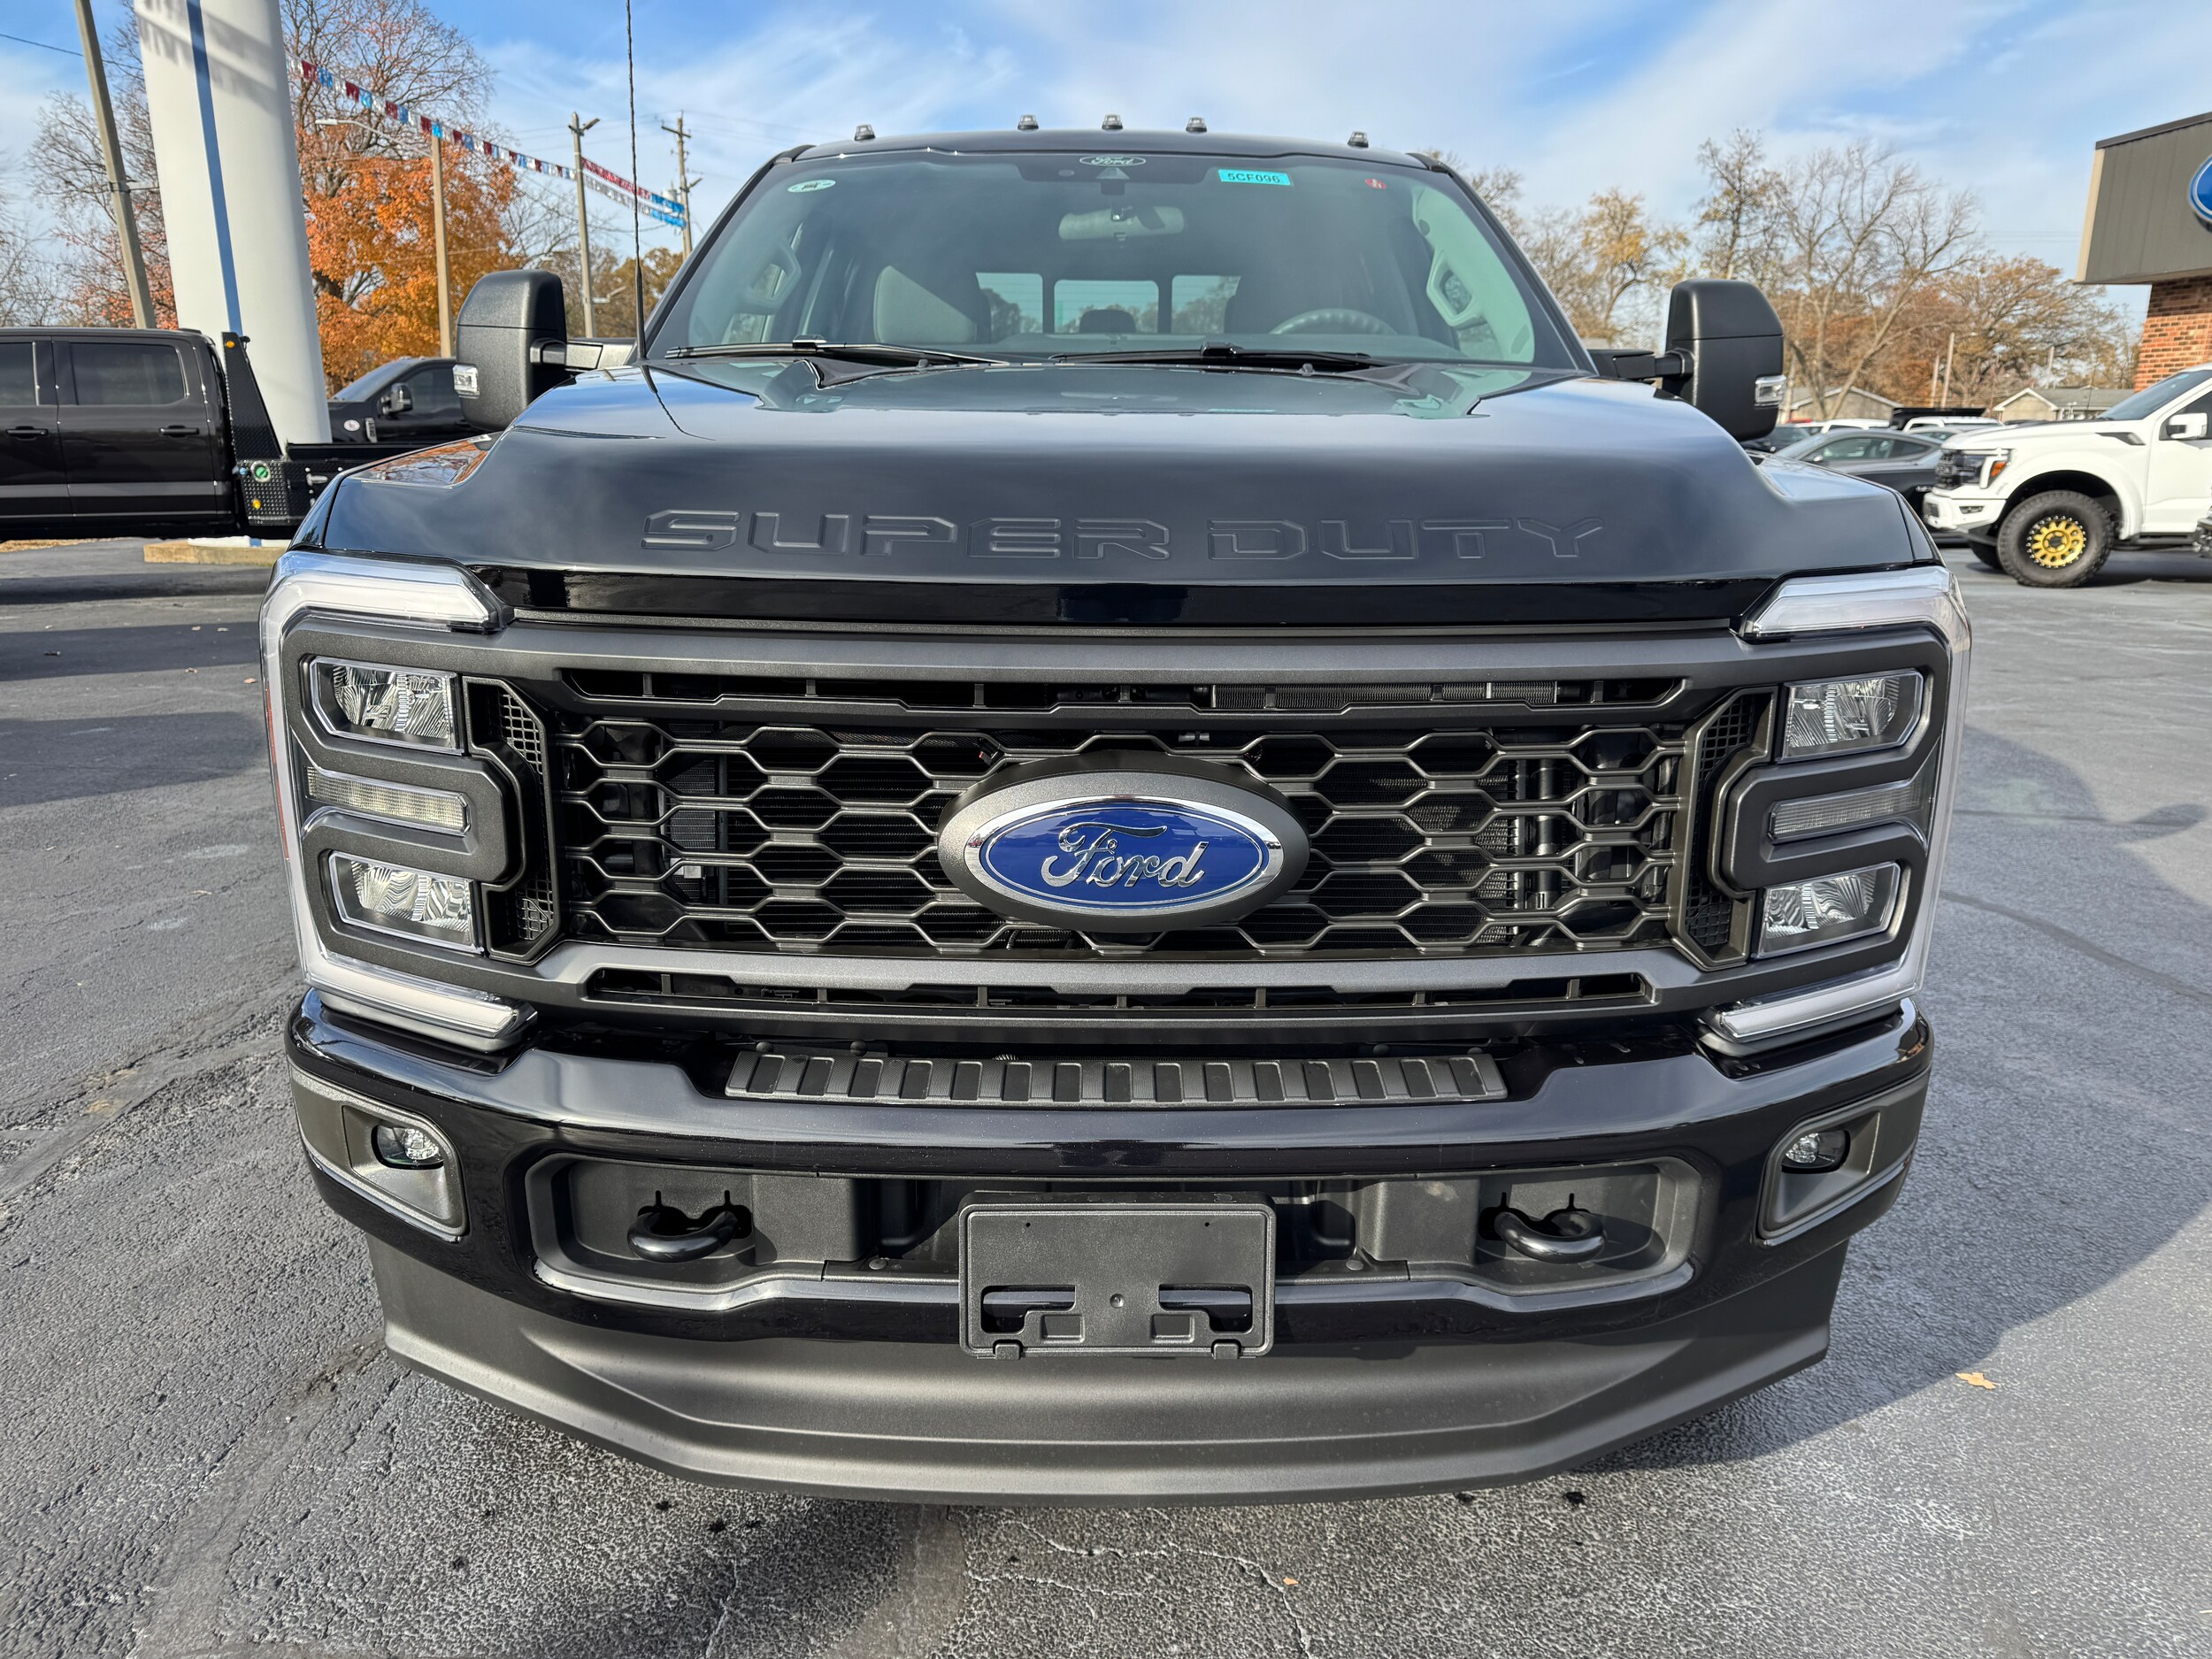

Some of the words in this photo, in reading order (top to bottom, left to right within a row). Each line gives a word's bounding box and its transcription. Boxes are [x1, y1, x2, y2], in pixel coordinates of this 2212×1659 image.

[1091, 156, 1134, 165] Ford
[641, 510, 1170, 560] SUPER
[1208, 518, 1603, 560] DUTY
[1041, 821, 1210, 887] Ford
